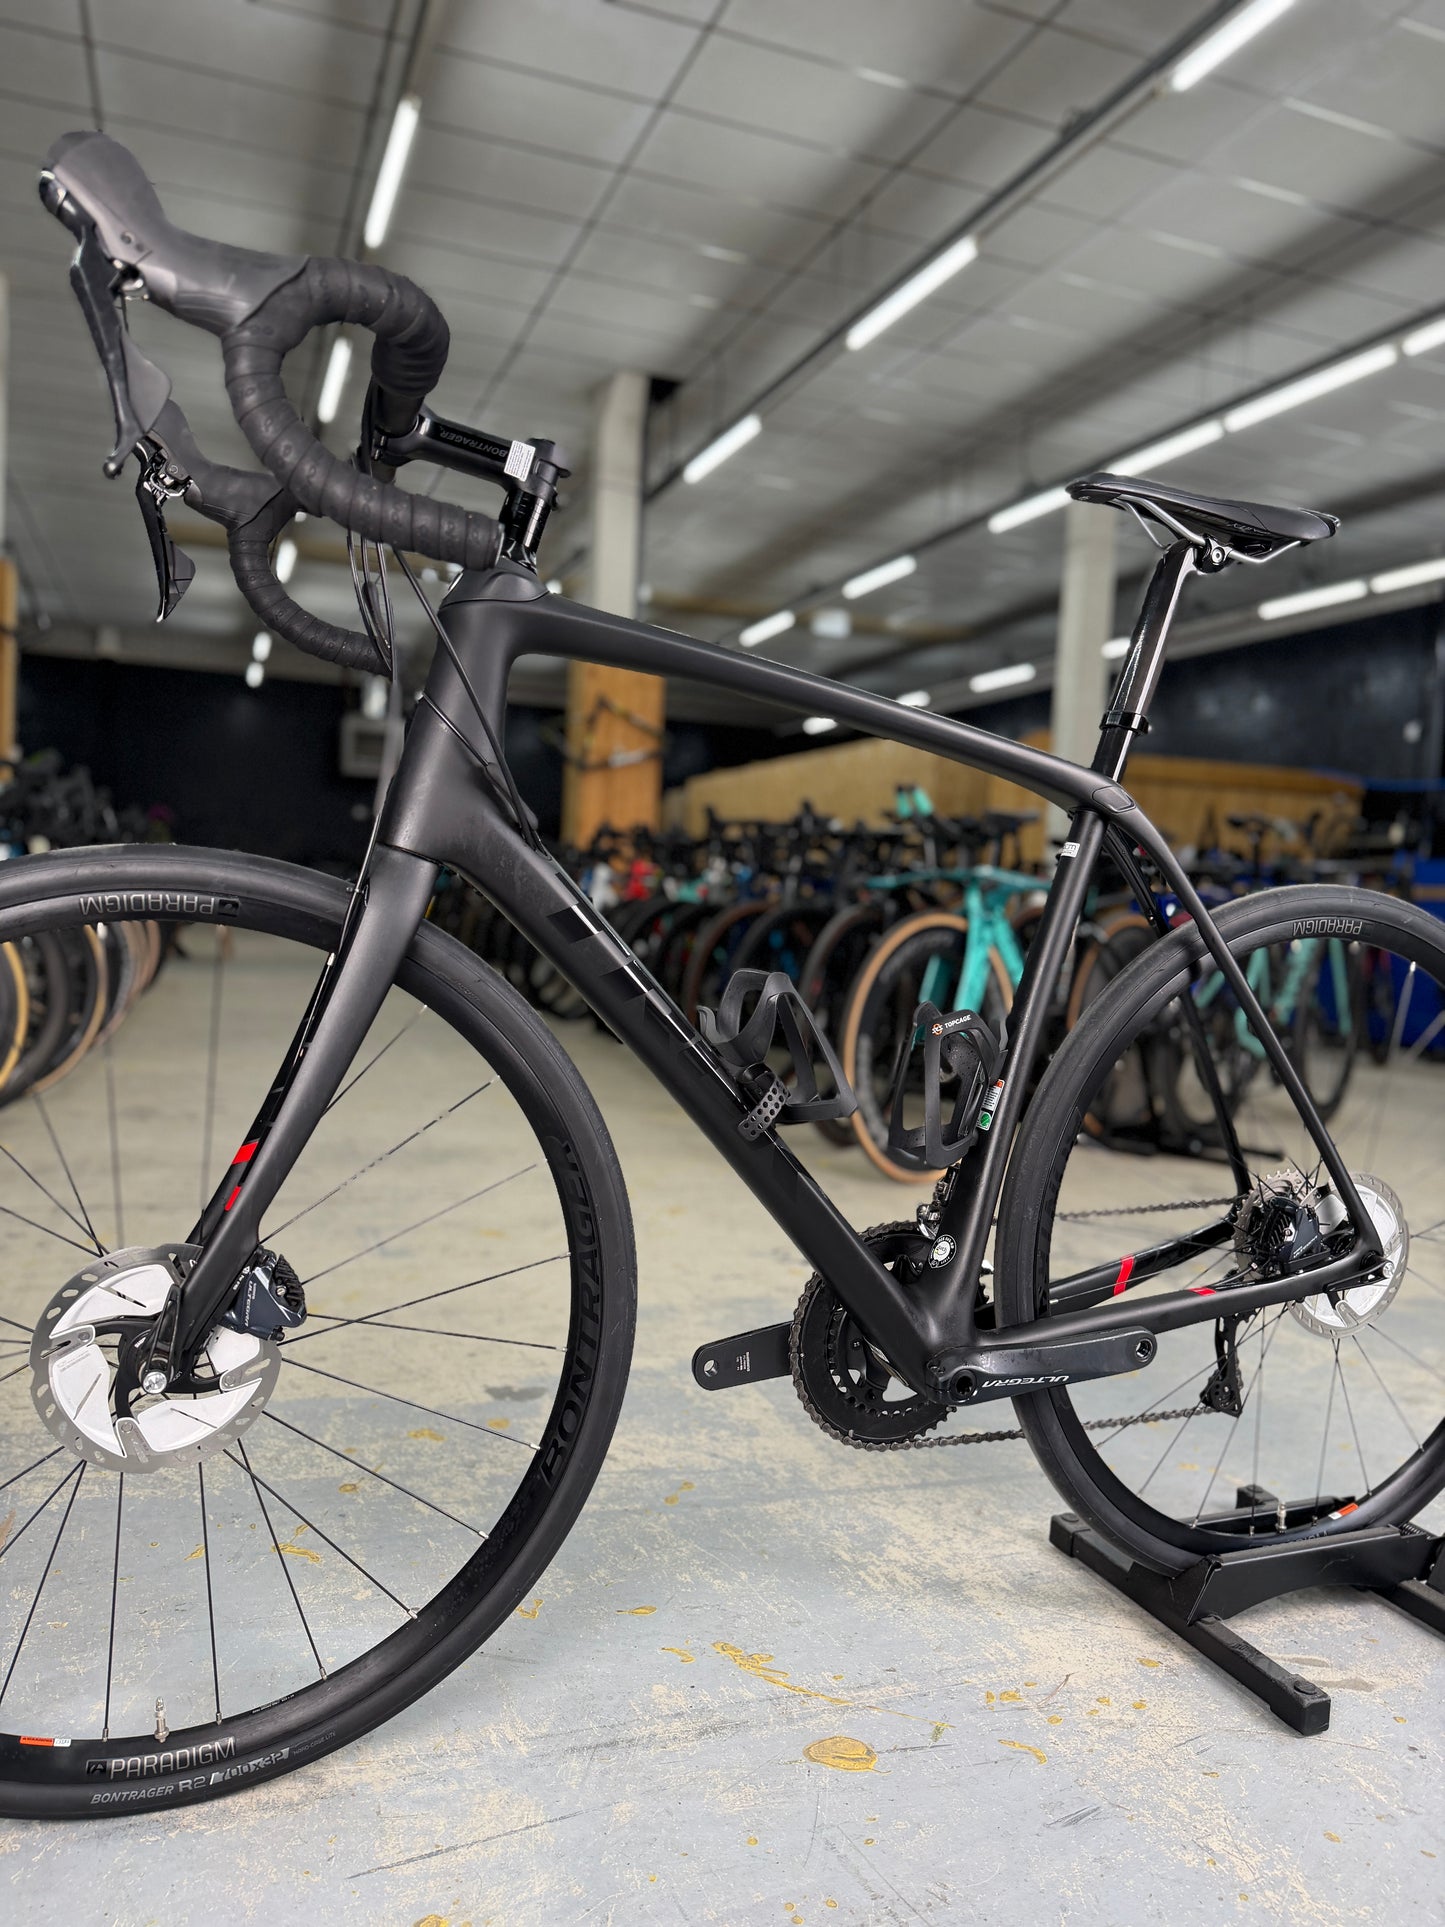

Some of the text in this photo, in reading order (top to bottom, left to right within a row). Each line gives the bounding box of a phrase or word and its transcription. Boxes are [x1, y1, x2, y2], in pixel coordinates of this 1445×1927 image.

[440, 430, 509, 458] BONTRAGER
[80, 893, 215, 915] PARADIGM
[1293, 919, 1363, 936] PARADIGM
[944, 1015, 972, 1028] TOPCAGE
[540, 1135, 601, 1487] BONTRAGER
[982, 1375, 1070, 1388] ULTEGRA
[110, 1736, 236, 1779] PARADIGM
[91, 1785, 174, 1804] BONTRAGER
[178, 1776, 206, 1793] R2
